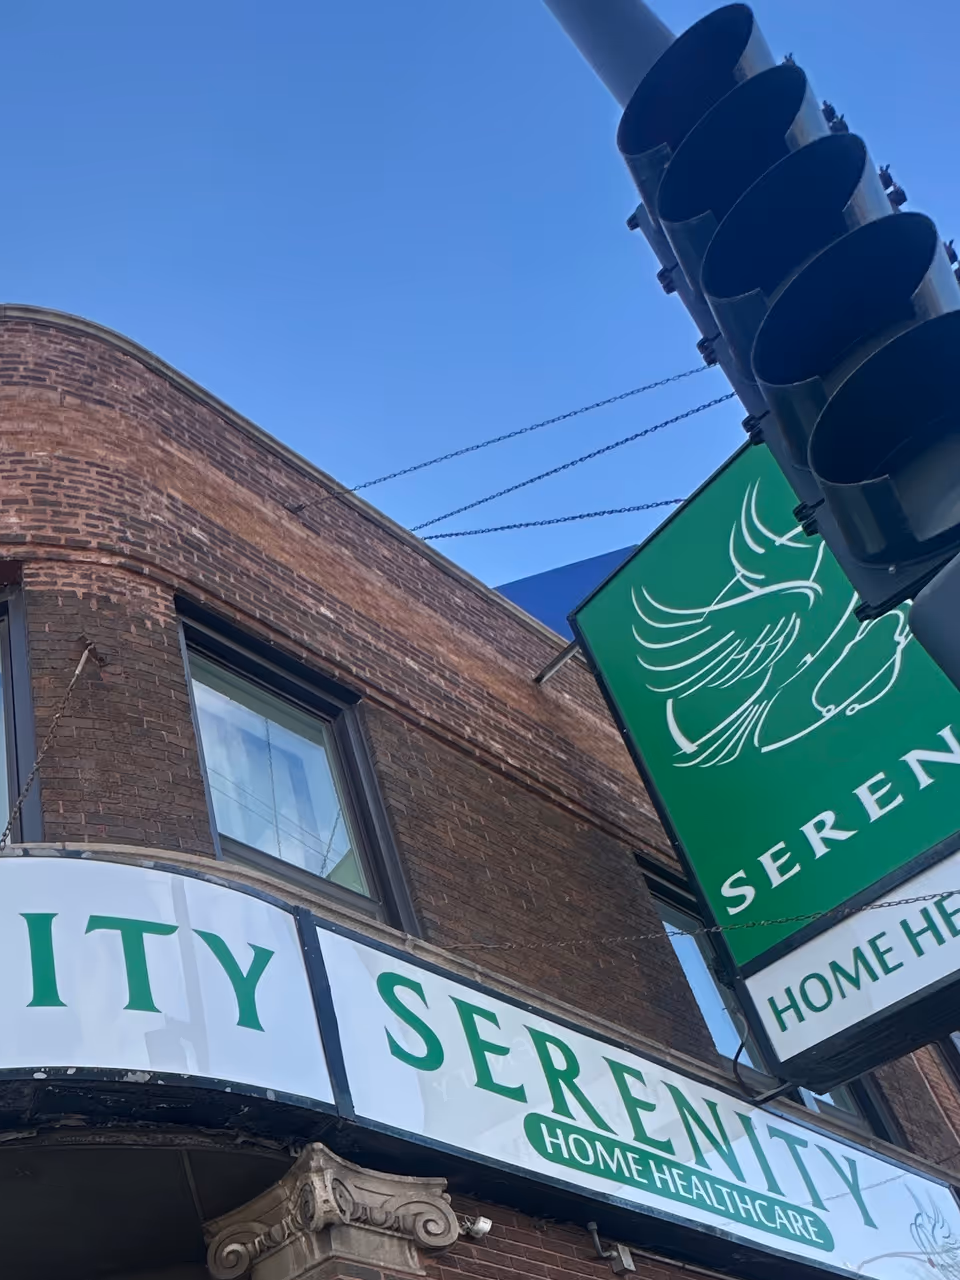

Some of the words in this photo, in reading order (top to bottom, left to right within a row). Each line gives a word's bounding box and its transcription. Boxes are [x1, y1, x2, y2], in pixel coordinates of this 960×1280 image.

[767, 930, 904, 1033] HOME
[376, 971, 878, 1230] SERENITY
[540, 1123, 648, 1184] HOME
[648, 1159, 824, 1243] HEALTHCARE
